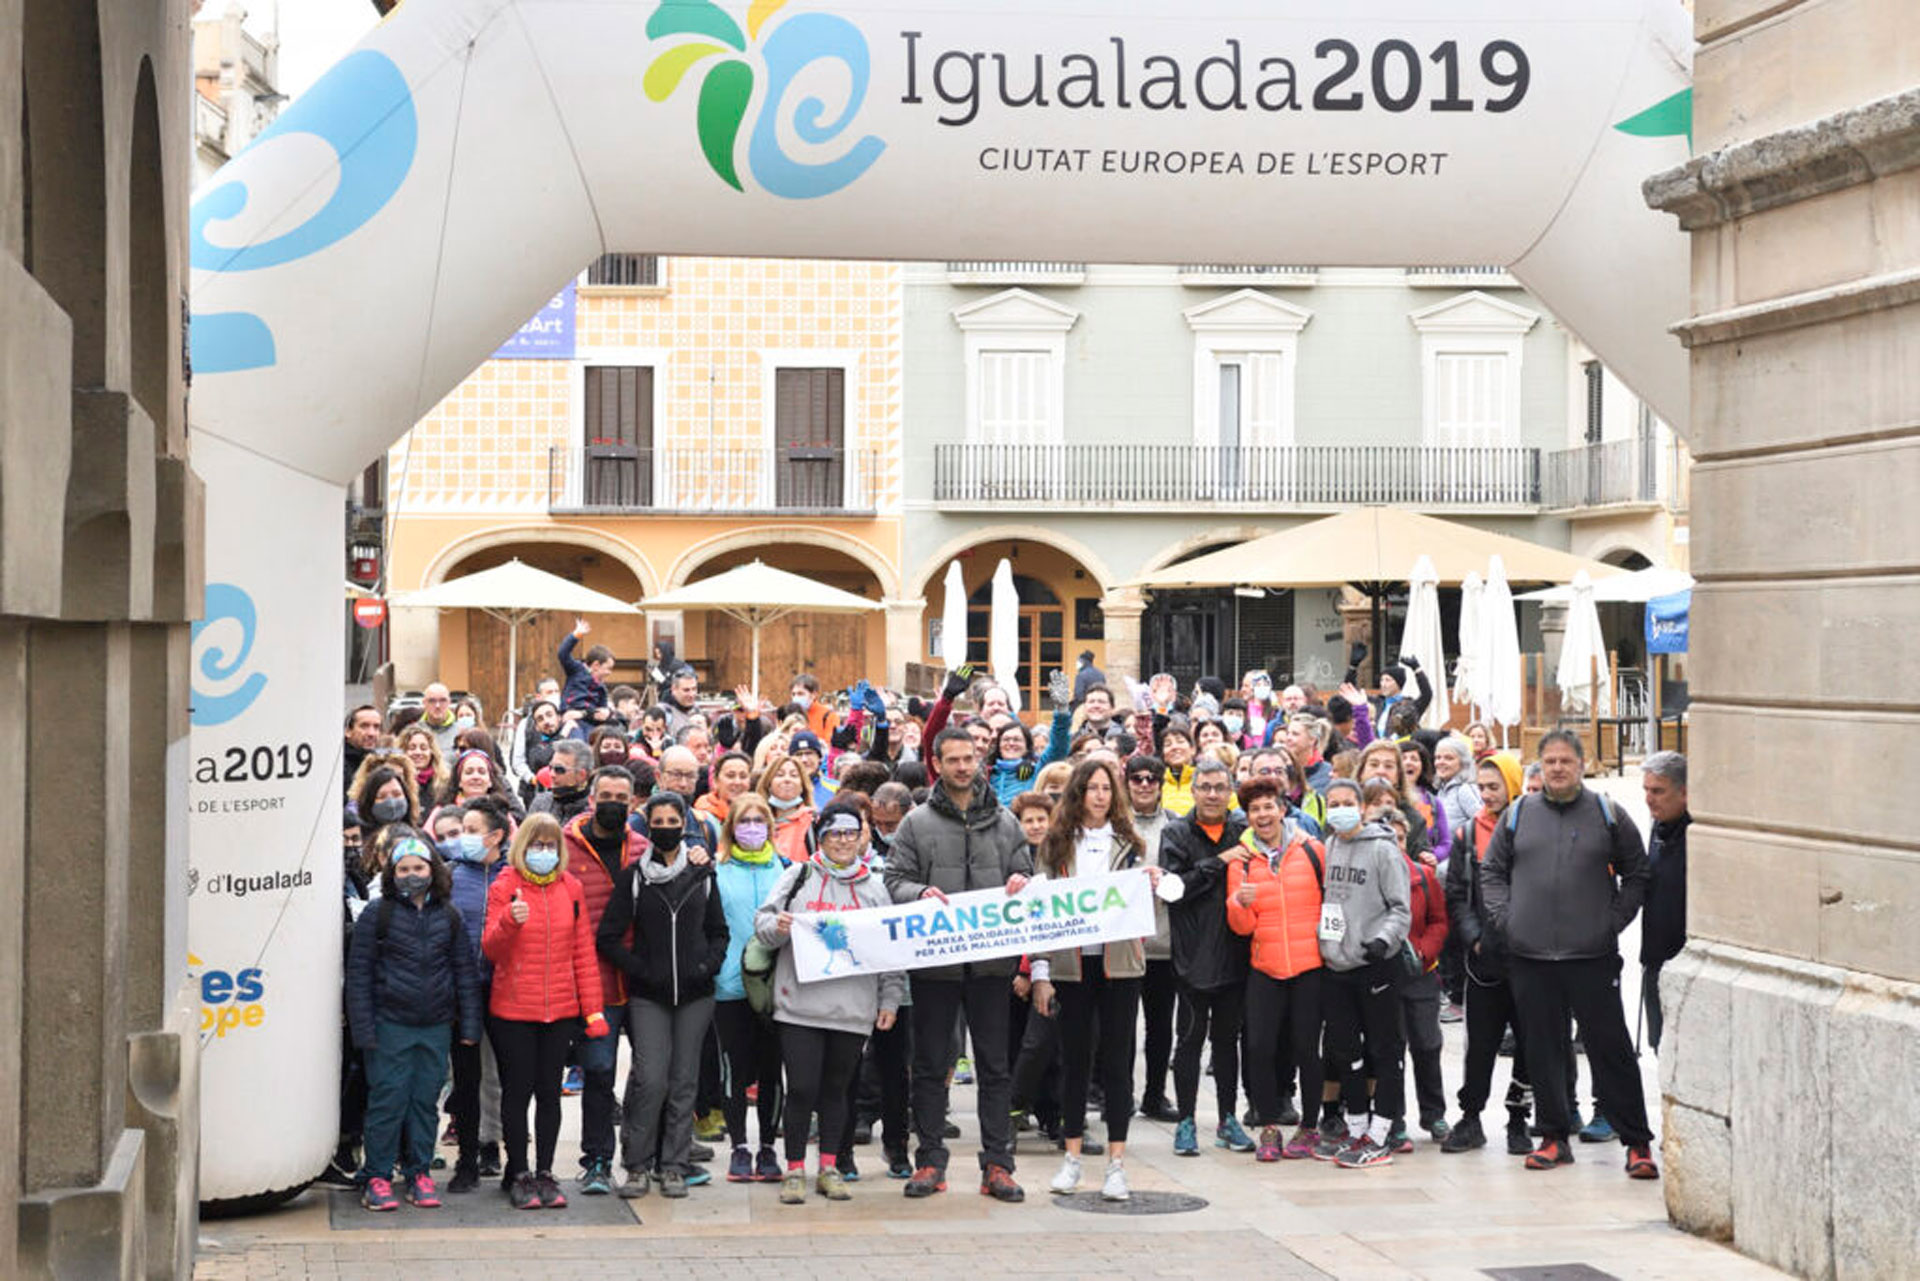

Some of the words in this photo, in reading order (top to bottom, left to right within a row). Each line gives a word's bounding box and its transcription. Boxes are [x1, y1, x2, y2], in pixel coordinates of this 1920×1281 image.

[901, 31, 1531, 126] Igualada2019
[979, 147, 1091, 173] CIUTAT
[1102, 149, 1245, 175] EUROPEA
[1256, 150, 1295, 175] DE
[1307, 151, 1448, 177] L'ESPORT
[189, 743, 313, 783] a2019
[198, 801, 218, 813] DE
[223, 796, 286, 812] L'ESPORT
[207, 871, 313, 897] d'Igualada
[927, 935, 965, 947] MARXA
[1031, 918, 1086, 932] PEDALADA
[915, 948, 935, 958] PER
[939, 946, 946, 955] A
[950, 943, 968, 954] LES
